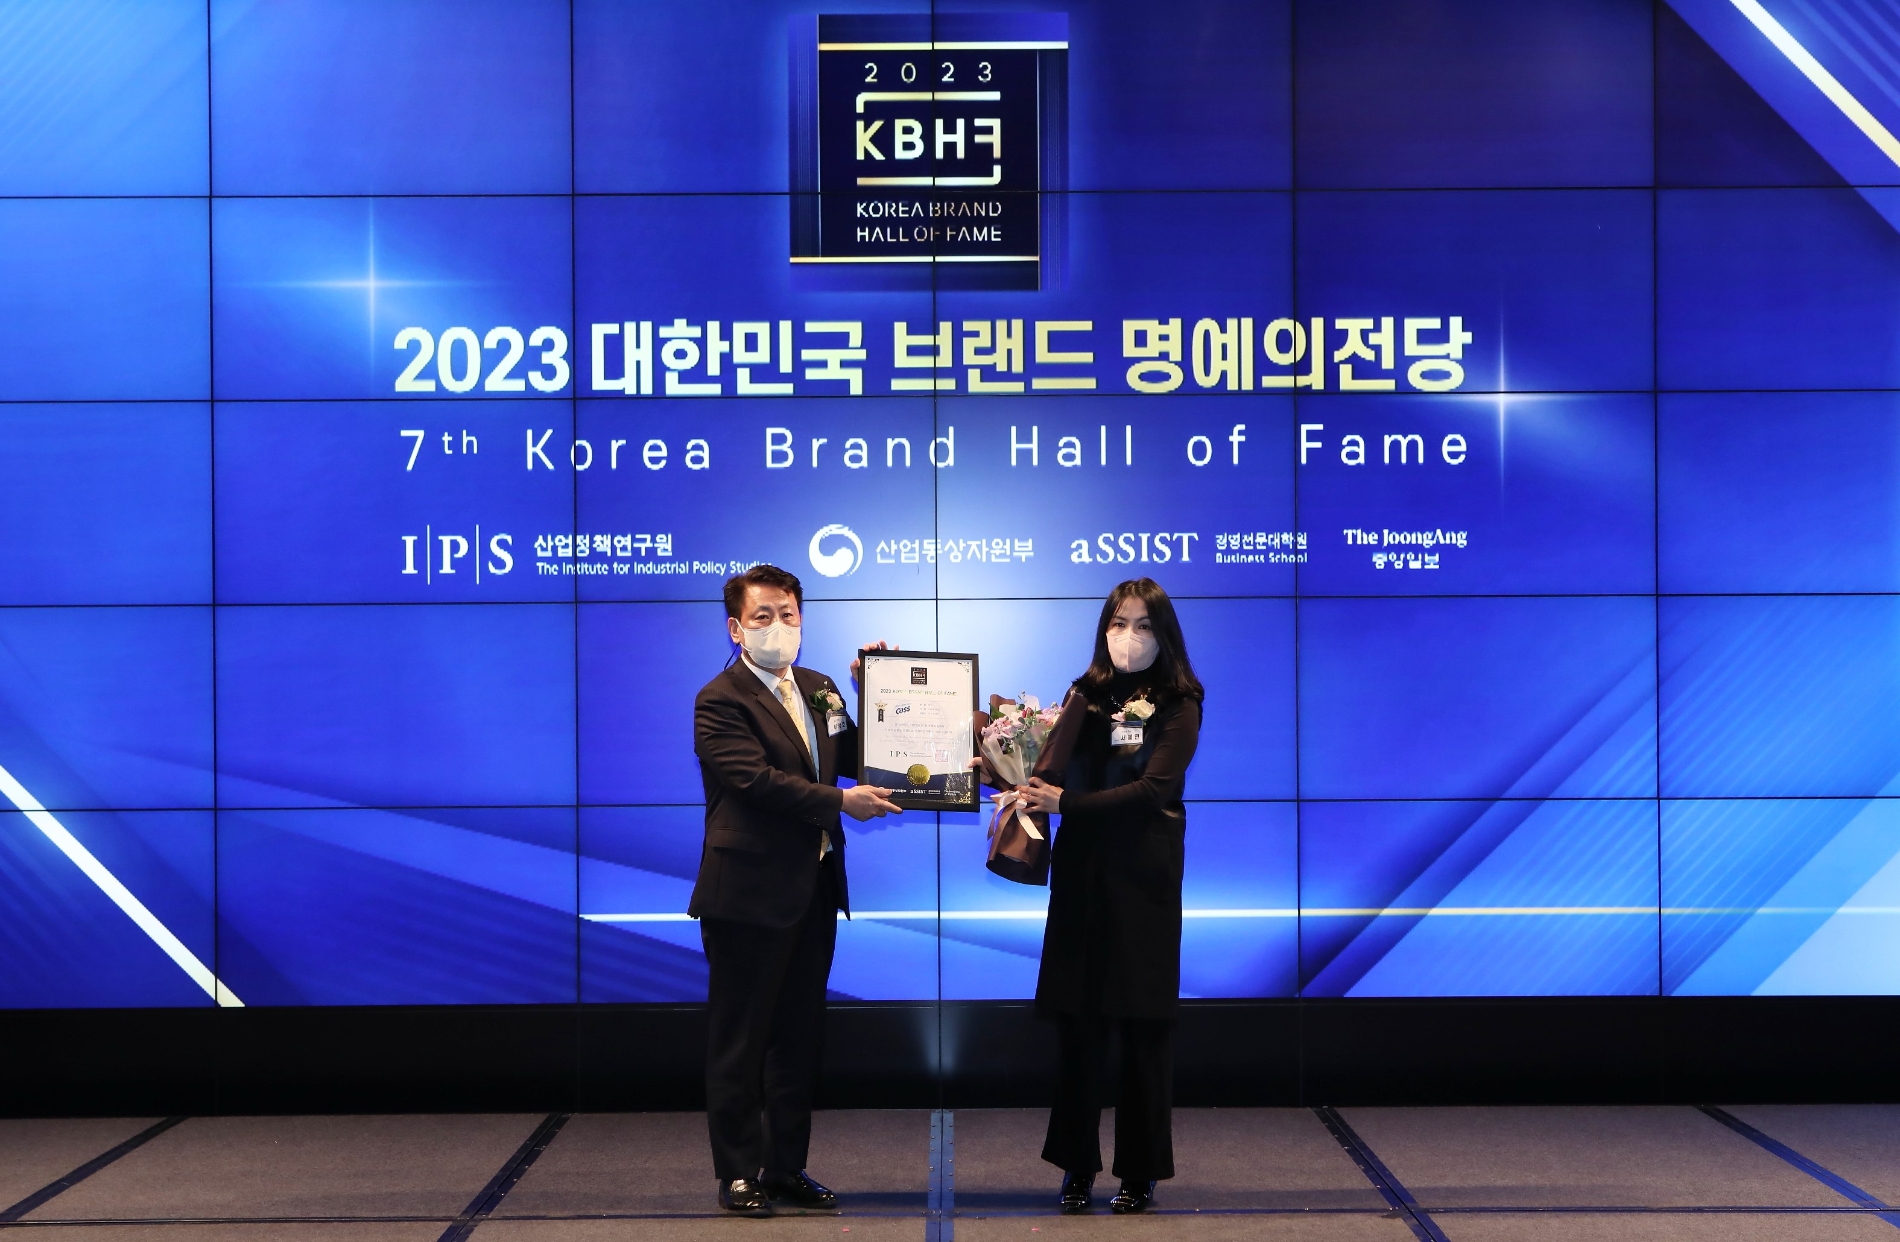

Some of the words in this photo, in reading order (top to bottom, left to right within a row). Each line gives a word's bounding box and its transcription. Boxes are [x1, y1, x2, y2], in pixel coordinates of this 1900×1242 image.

[864, 62, 992, 83] 2023
[856, 118, 1002, 161] KBHF
[856, 201, 924, 218] KOREA
[929, 201, 1002, 217] BRAND
[856, 226, 909, 243] HALL
[913, 226, 940, 242] OF
[946, 226, 1002, 242] FAME
[393, 326, 570, 393] 2023
[591, 318, 867, 396] 대한민국
[890, 318, 1097, 393] 브랜드
[1122, 316, 1473, 394] 명예의전당
[400, 429, 478, 471] 7th
[526, 428, 710, 471] Korea
[765, 426, 955, 470] Brand
[1010, 425, 1132, 468] Hall
[1186, 424, 1246, 467] of
[1300, 423, 1467, 466] Fame
[533, 533, 673, 558] 산업정책연구원
[1070, 532, 1199, 565] aSSIST
[1343, 528, 1379, 546] The
[1382, 528, 1468, 549] JoongAng
[875, 537, 1035, 565] 산업통상자원부
[1215, 552, 1265, 564] Business
[1268, 552, 1308, 564] School
[535, 561, 559, 576] The
[612, 561, 631, 575] for
[633, 561, 689, 575] Industrial
[692, 561, 727, 577] Policy
